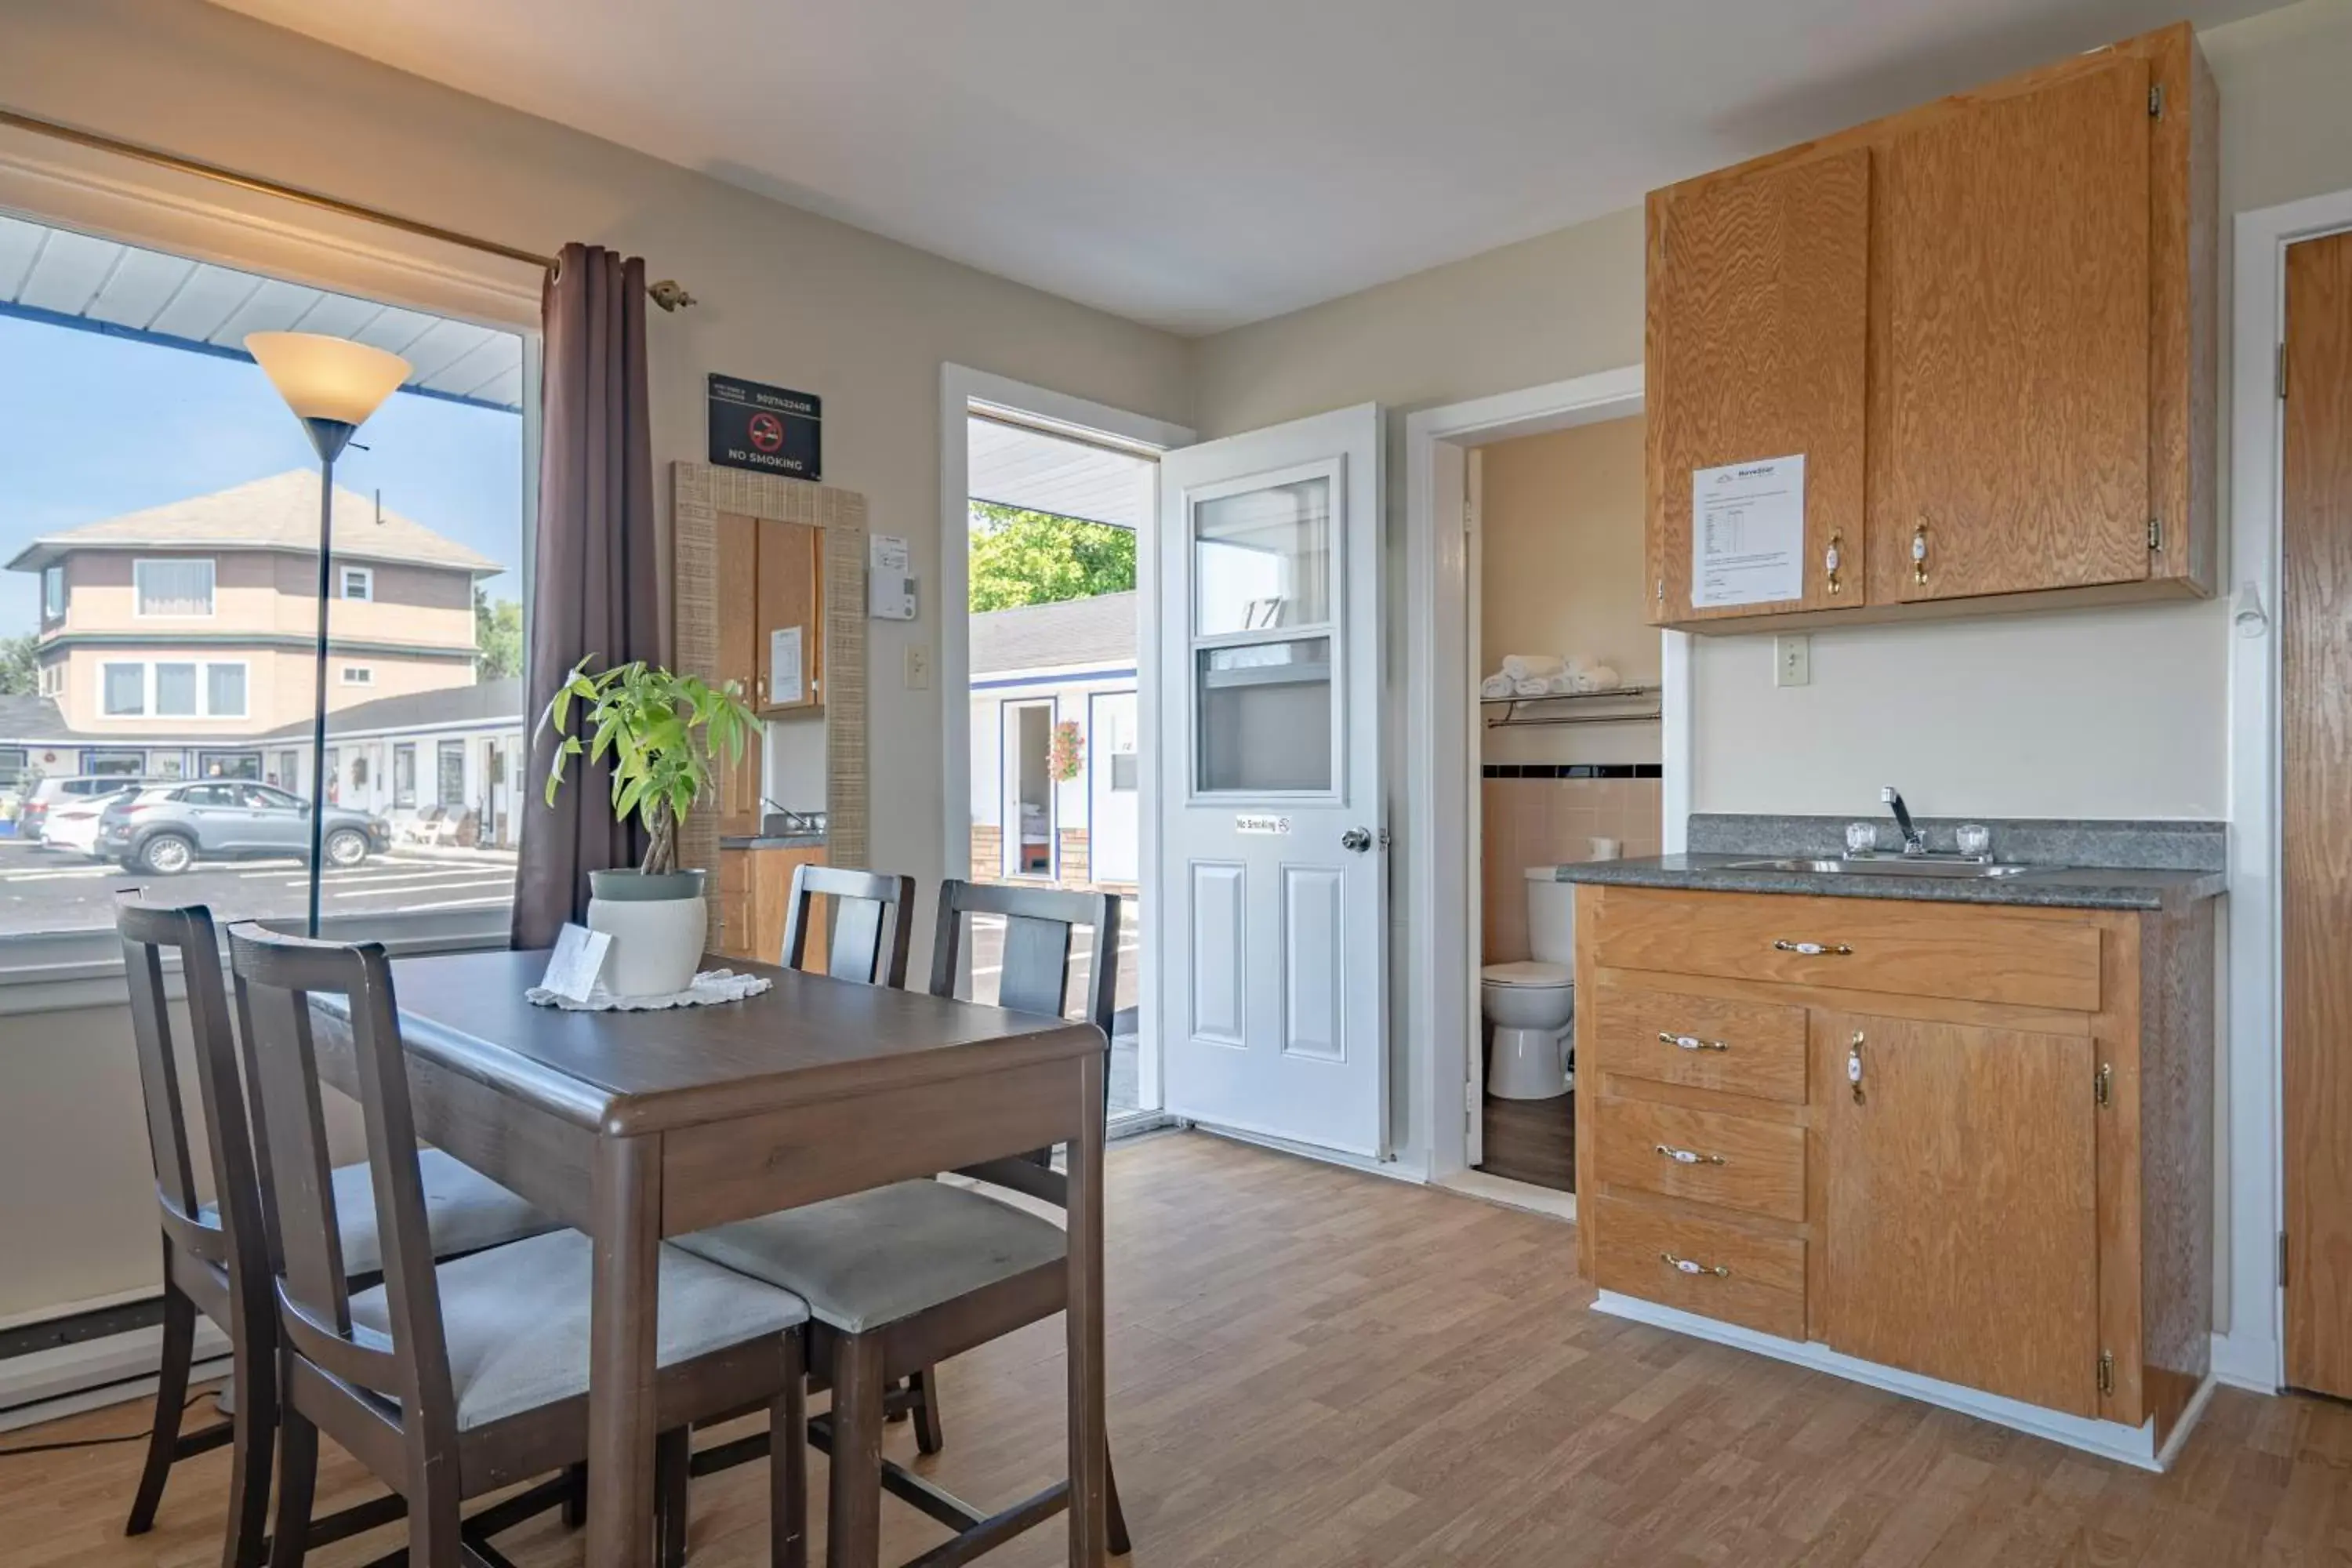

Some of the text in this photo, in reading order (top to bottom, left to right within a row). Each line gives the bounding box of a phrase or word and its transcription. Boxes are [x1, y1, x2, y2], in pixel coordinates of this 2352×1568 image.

[728, 448, 803, 470] NO SMOKING
[1244, 598, 1279, 630] 17
[1247, 818, 1276, 832] Smoking
